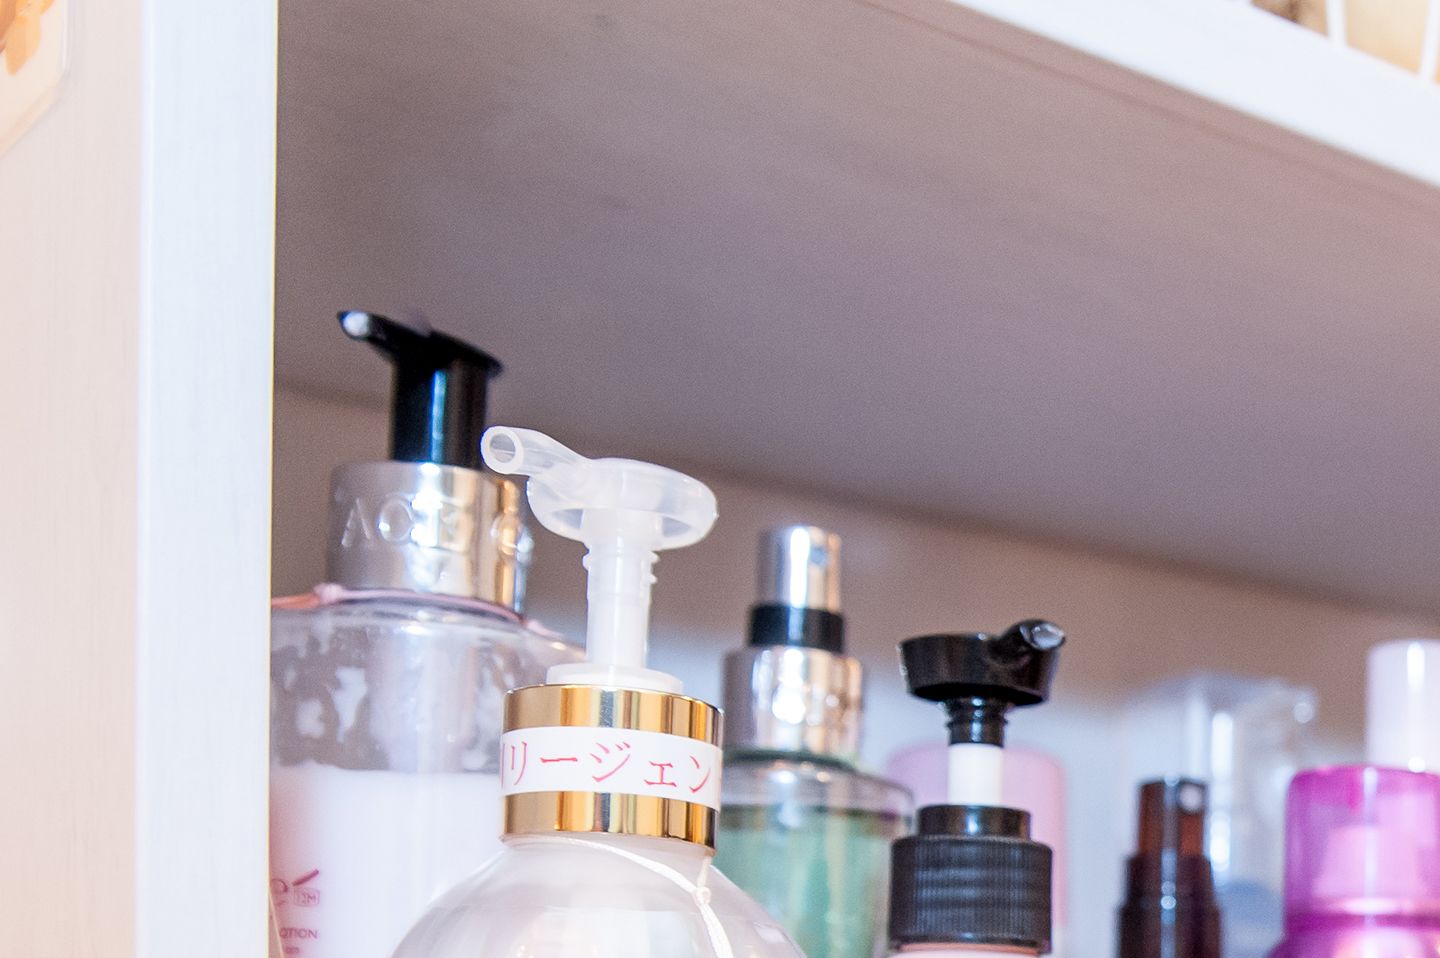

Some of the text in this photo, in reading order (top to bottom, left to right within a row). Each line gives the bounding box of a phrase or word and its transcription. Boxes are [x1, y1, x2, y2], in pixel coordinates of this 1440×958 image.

[501, 740, 712, 794] リージェン
[279, 926, 318, 940] OTION
